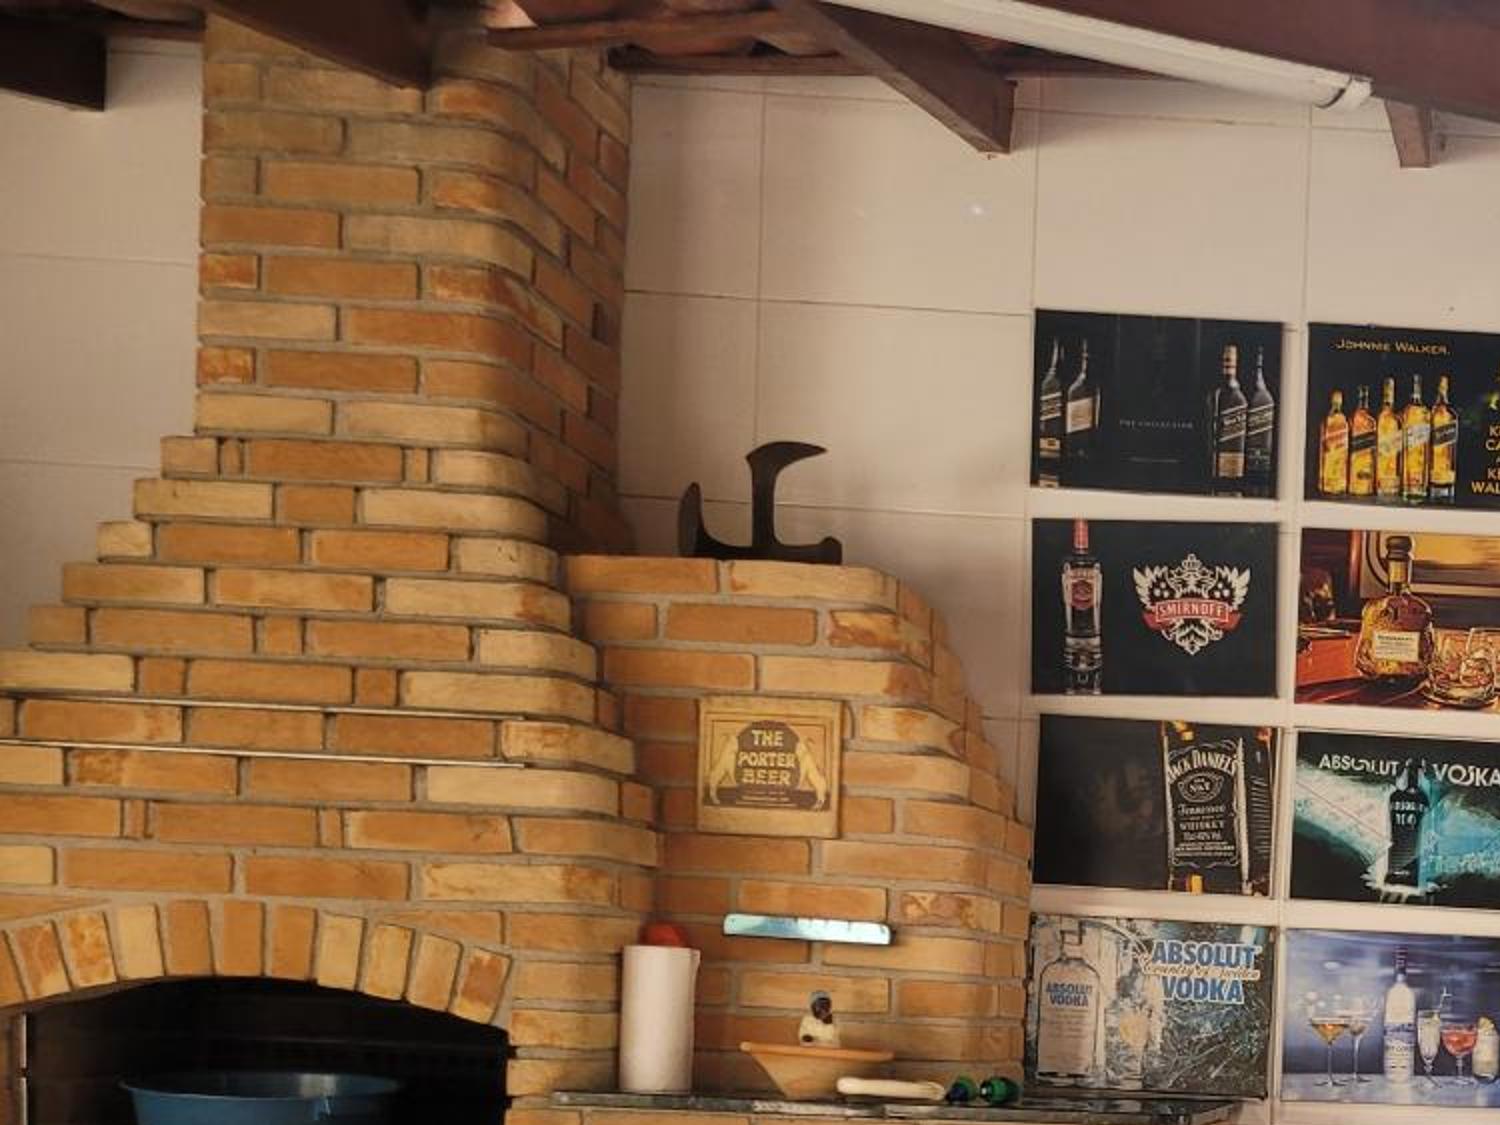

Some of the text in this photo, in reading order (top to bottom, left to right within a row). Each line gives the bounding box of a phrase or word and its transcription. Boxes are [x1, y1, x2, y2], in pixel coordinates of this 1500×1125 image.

[1157, 602, 1225, 618] SMIRNOFF
[751, 729, 785, 747] THE
[737, 751, 796, 768] PORTER
[742, 768, 791, 785] BEER
[1152, 941, 1260, 968] ABSOLUT
[1162, 978, 1244, 1003] VODKA
